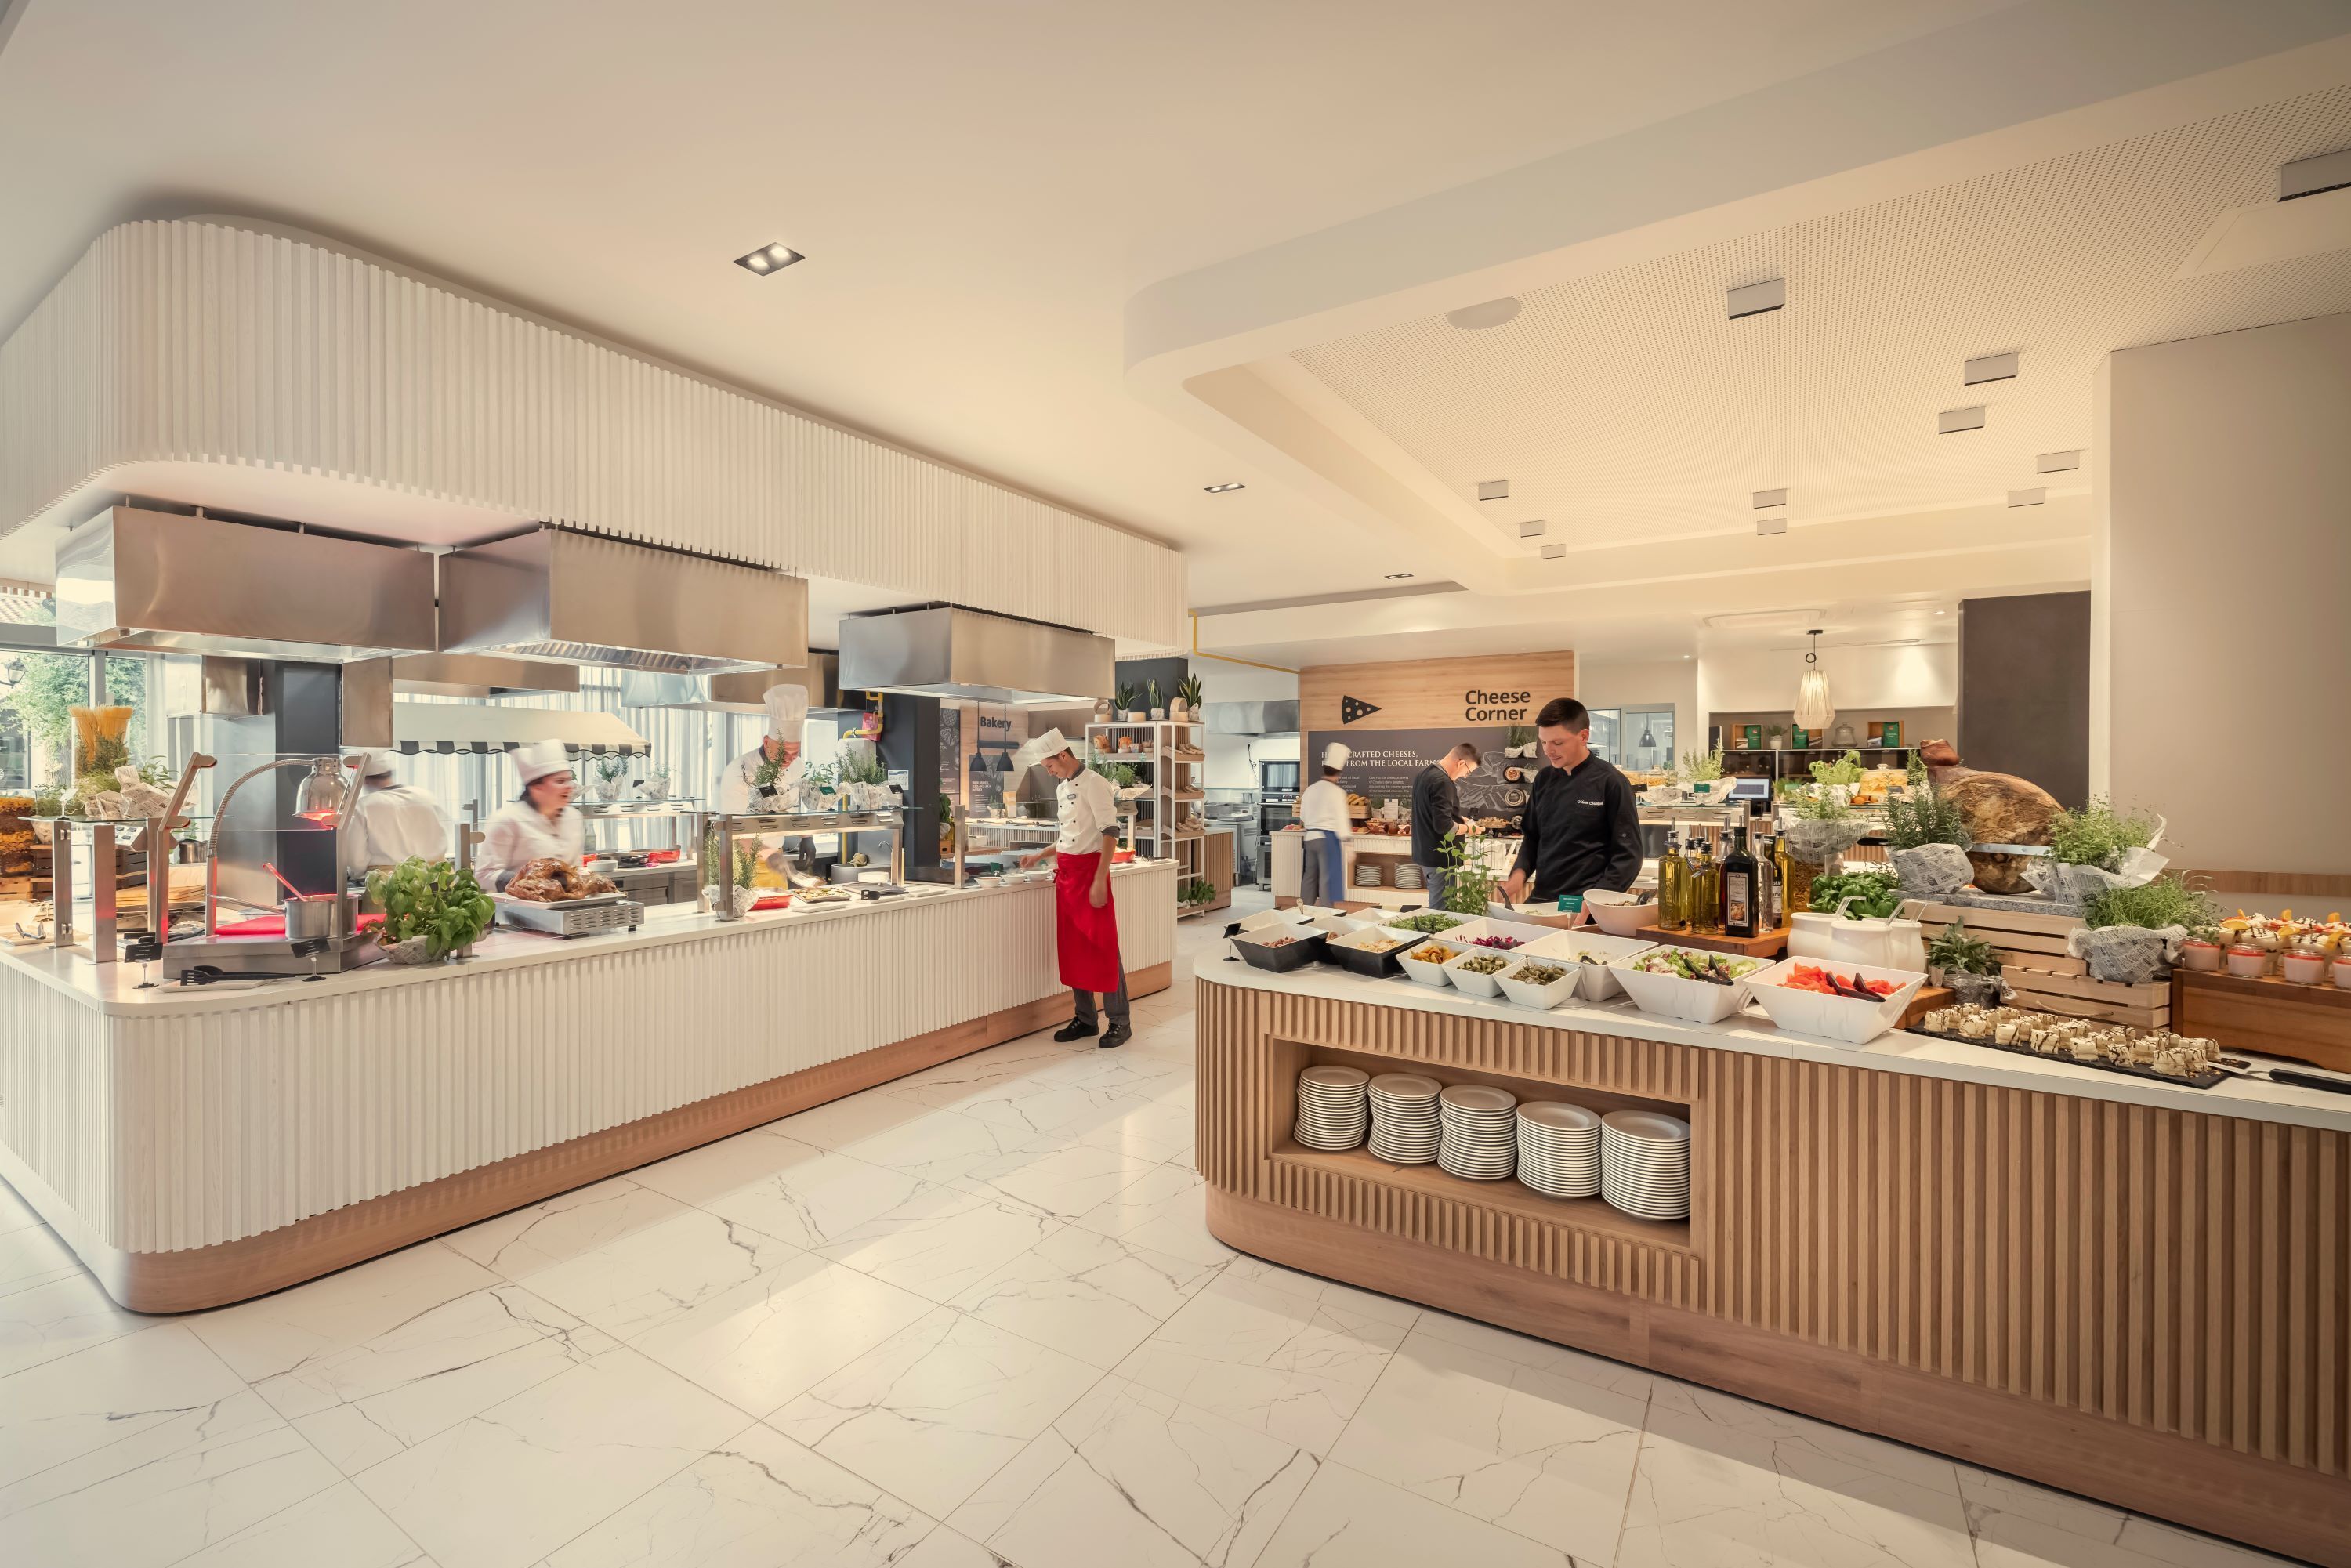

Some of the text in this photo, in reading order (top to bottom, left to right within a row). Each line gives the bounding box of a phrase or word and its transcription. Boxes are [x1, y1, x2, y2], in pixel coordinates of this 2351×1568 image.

[1465, 689, 1531, 704] Cheese
[1465, 707, 1527, 722] Corner
[980, 716, 1012, 731] Bakery
